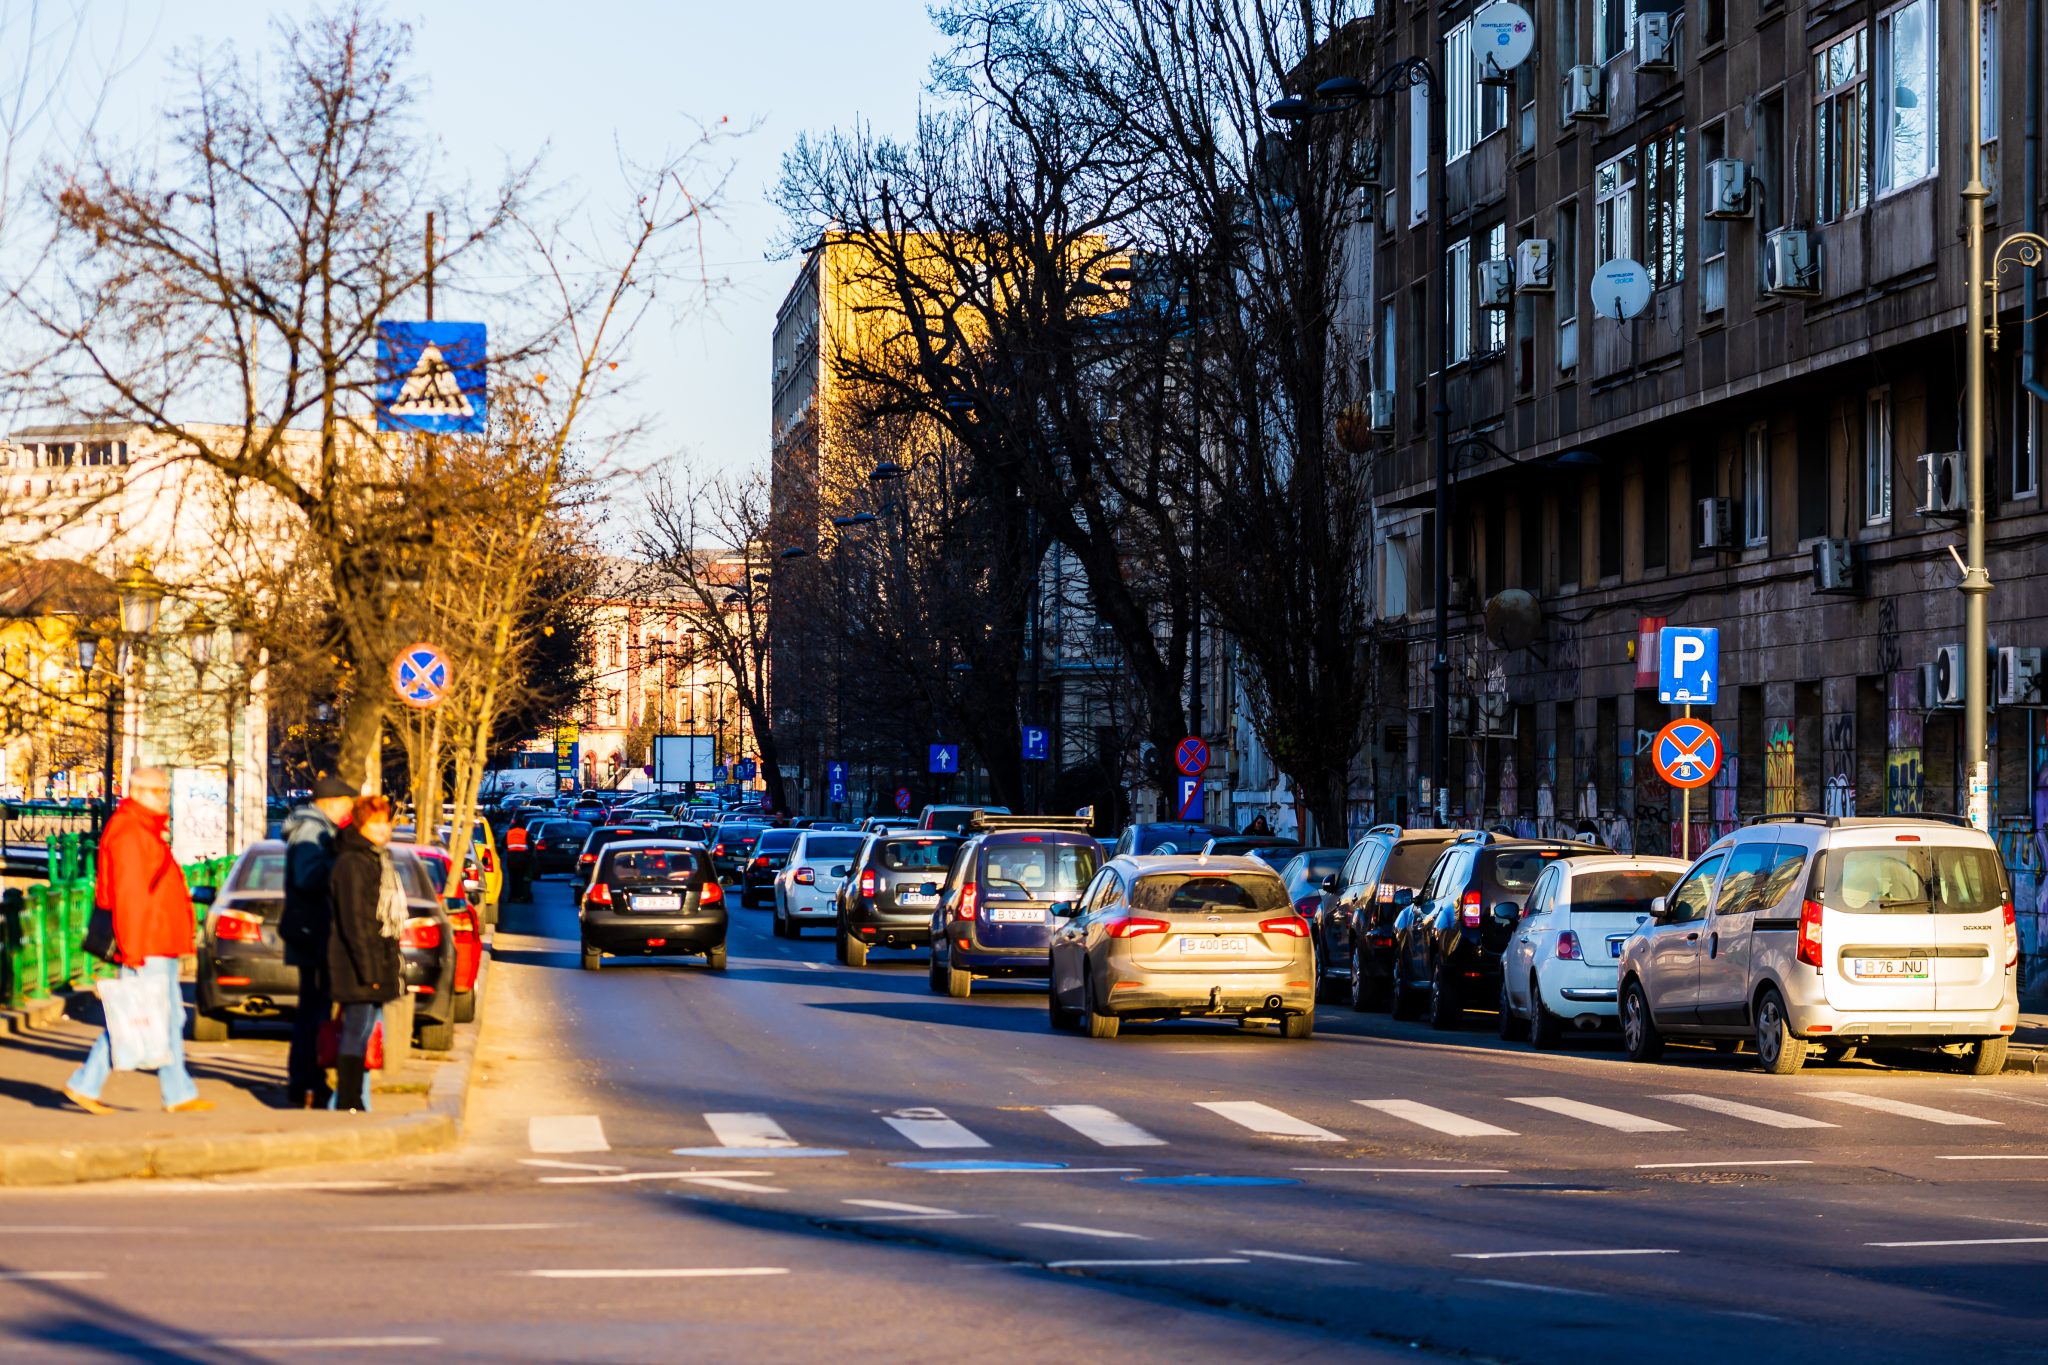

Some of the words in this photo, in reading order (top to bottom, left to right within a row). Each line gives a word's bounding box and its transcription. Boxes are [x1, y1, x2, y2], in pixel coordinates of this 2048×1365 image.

[1674, 636, 1704, 679] P
[1029, 730, 1043, 748] P
[833, 783, 842, 796] P
[1185, 780, 1198, 805] P
[998, 910, 1005, 919] B
[1188, 940, 1196, 950] B
[1200, 939, 1219, 950] 400
[1221, 939, 1244, 950] BCL
[1865, 961, 1875, 973] B
[1878, 961, 1893, 973] 76
[1898, 961, 1922, 973] JNU
